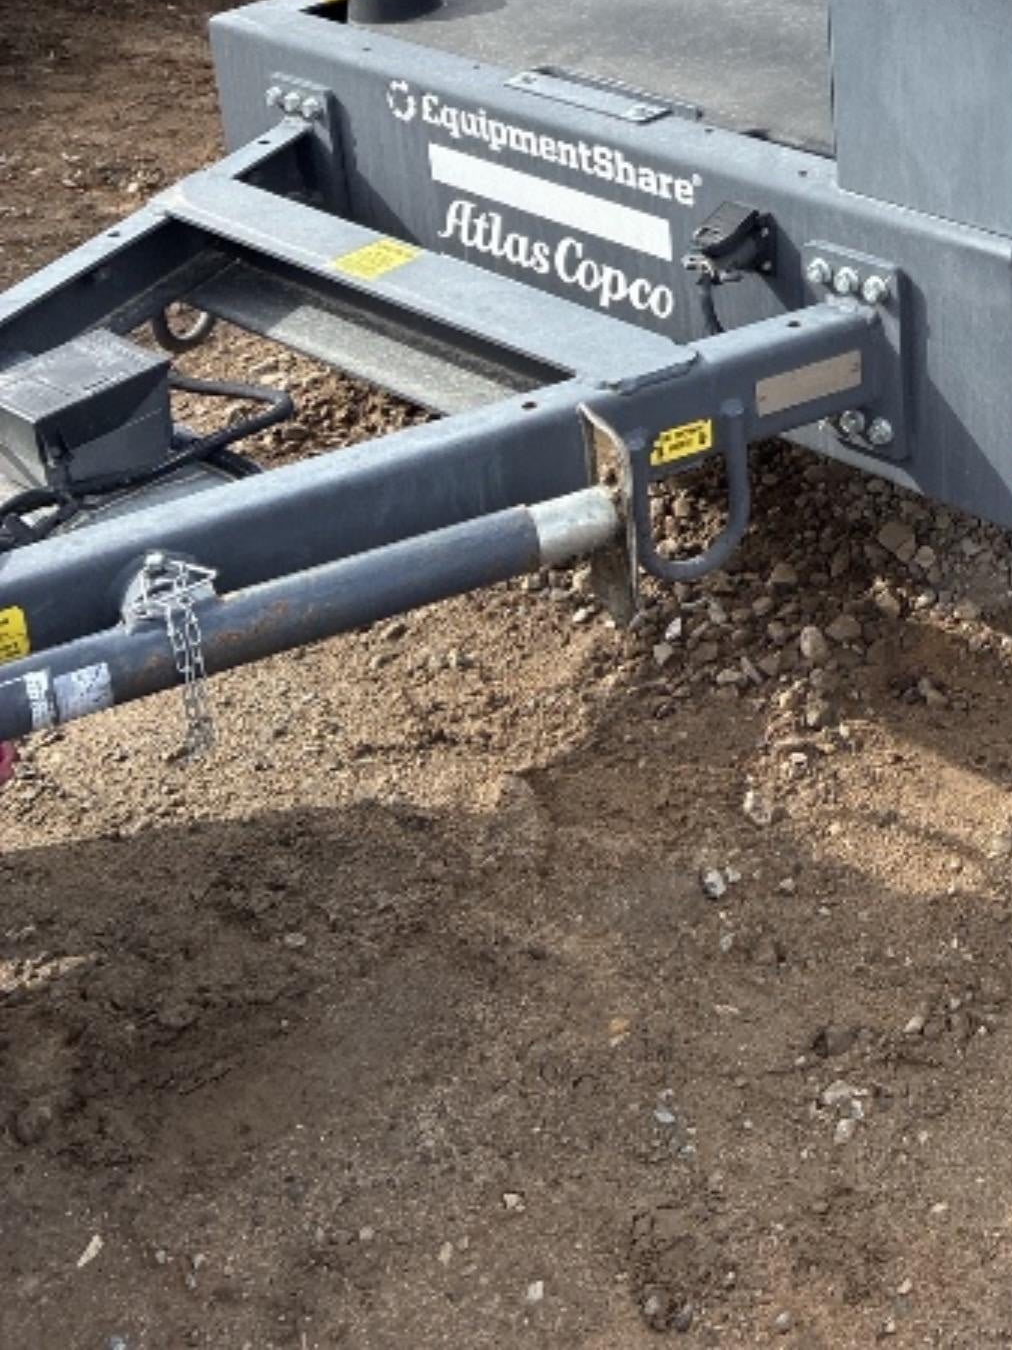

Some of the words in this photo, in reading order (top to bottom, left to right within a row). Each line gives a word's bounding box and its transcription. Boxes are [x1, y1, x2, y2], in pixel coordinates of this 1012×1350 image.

[421, 92, 695, 206] EquipmentShare
[437, 199, 550, 276] Atlas
[554, 236, 674, 320] Copco
